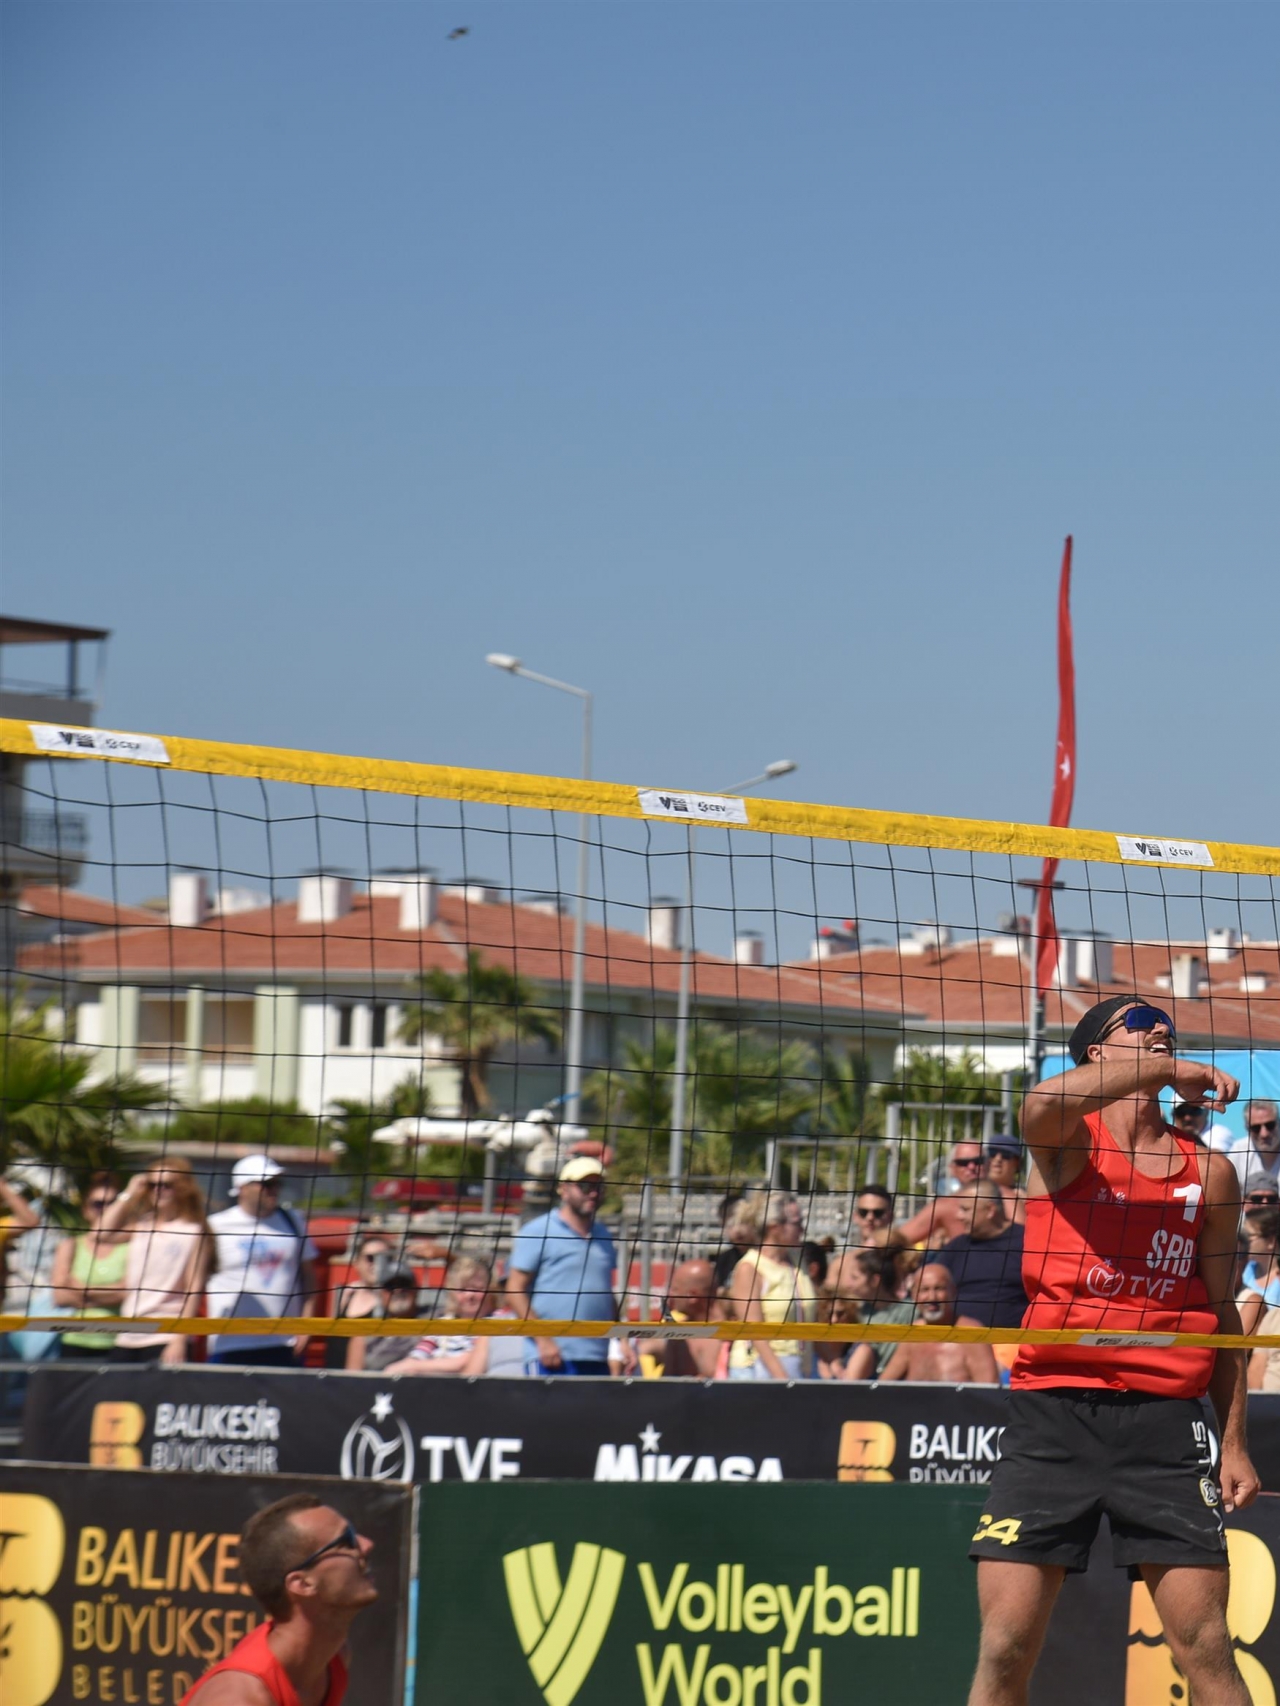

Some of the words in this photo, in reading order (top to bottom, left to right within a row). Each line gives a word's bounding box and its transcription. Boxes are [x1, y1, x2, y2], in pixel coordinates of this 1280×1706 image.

[709, 803, 726, 812] CEV
[1179, 848, 1194, 856] CEV
[1172, 1183, 1202, 1223] 1
[1146, 1229, 1194, 1277] SRB
[1130, 1275, 1176, 1299] TVF
[421, 1436, 524, 1482] TVF
[75, 1526, 254, 1596] BALIKE
[637, 1562, 920, 1654] Volleyball
[636, 1643, 822, 1706] World
